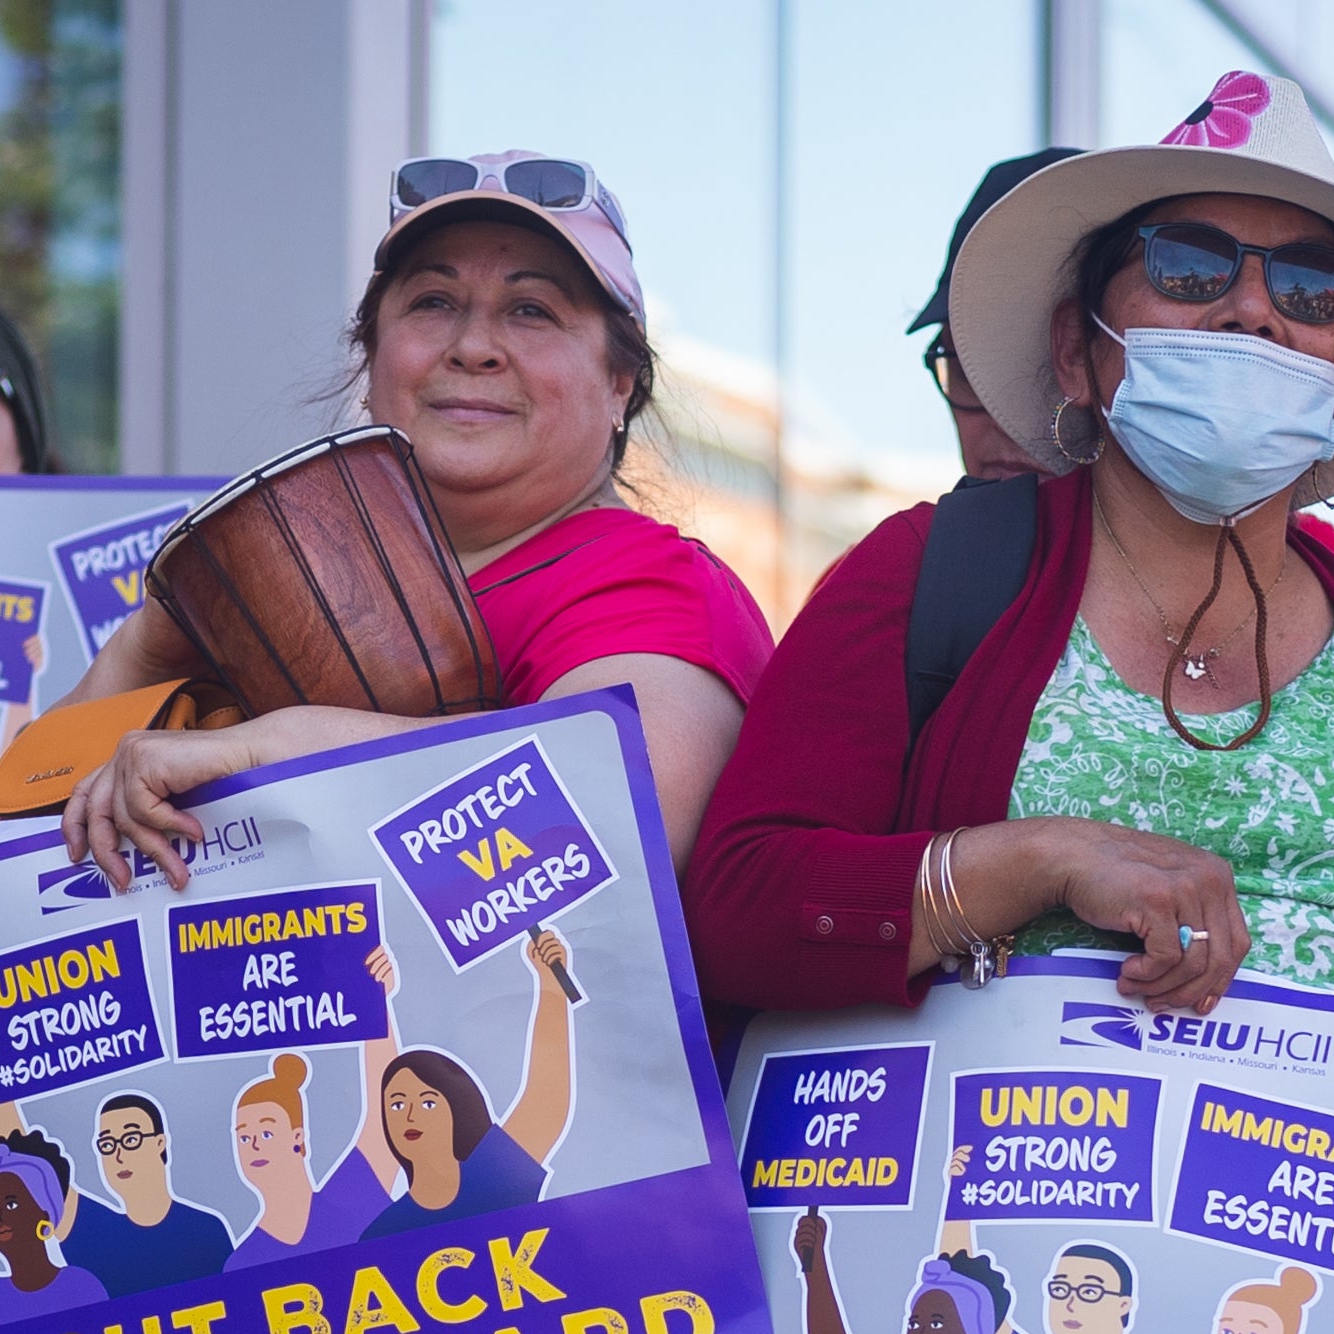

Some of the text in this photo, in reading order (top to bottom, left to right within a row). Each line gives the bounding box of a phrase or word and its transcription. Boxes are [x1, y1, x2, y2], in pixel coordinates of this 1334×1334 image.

[70, 518, 179, 582] PROTEC
[111, 567, 147, 607] V
[399, 762, 538, 865] PROTECT
[238, 851, 265, 864] Kansas
[458, 828, 533, 881] VA
[445, 843, 591, 947] WORKERS
[178, 902, 367, 953] IMMIGRANTS
[242, 951, 299, 991] ARE
[7, 990, 121, 1051] STRONG
[199, 991, 357, 1042] ESSENTIAL
[1147, 1045, 1327, 1077] Illinois Indiana Missouri Kansas
[793, 1066, 887, 1105] HANDS
[980, 1086, 1129, 1128] UNION
[805, 1112, 860, 1148] OFF
[752, 1157, 899, 1188] MEDICAID
[985, 1135, 1118, 1173] STRONG
[960, 1179, 1140, 1210] #SOLIDARITY
